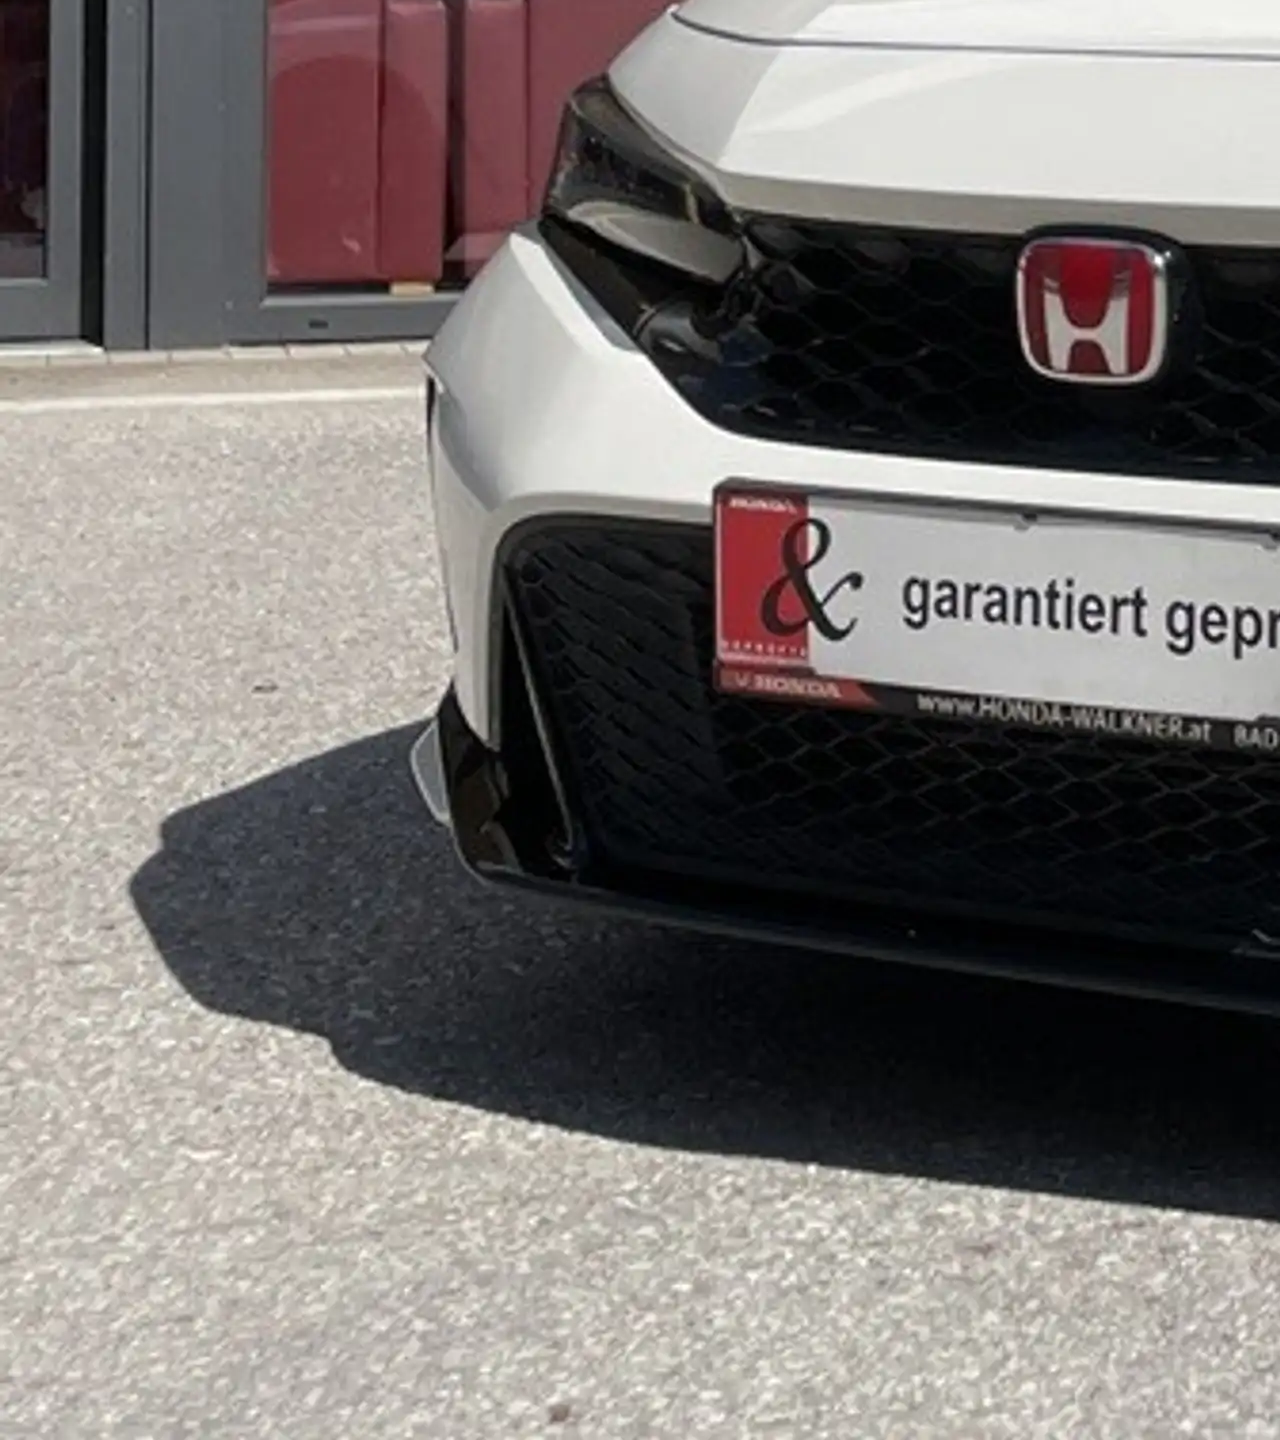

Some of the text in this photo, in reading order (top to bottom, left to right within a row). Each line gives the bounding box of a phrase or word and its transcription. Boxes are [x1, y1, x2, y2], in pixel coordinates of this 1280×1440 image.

[902, 574, 1148, 638] garantiert
[916, 692, 1212, 744] www.HONDA-WALKNER.at
[1233, 724, 1280, 752] BAD
